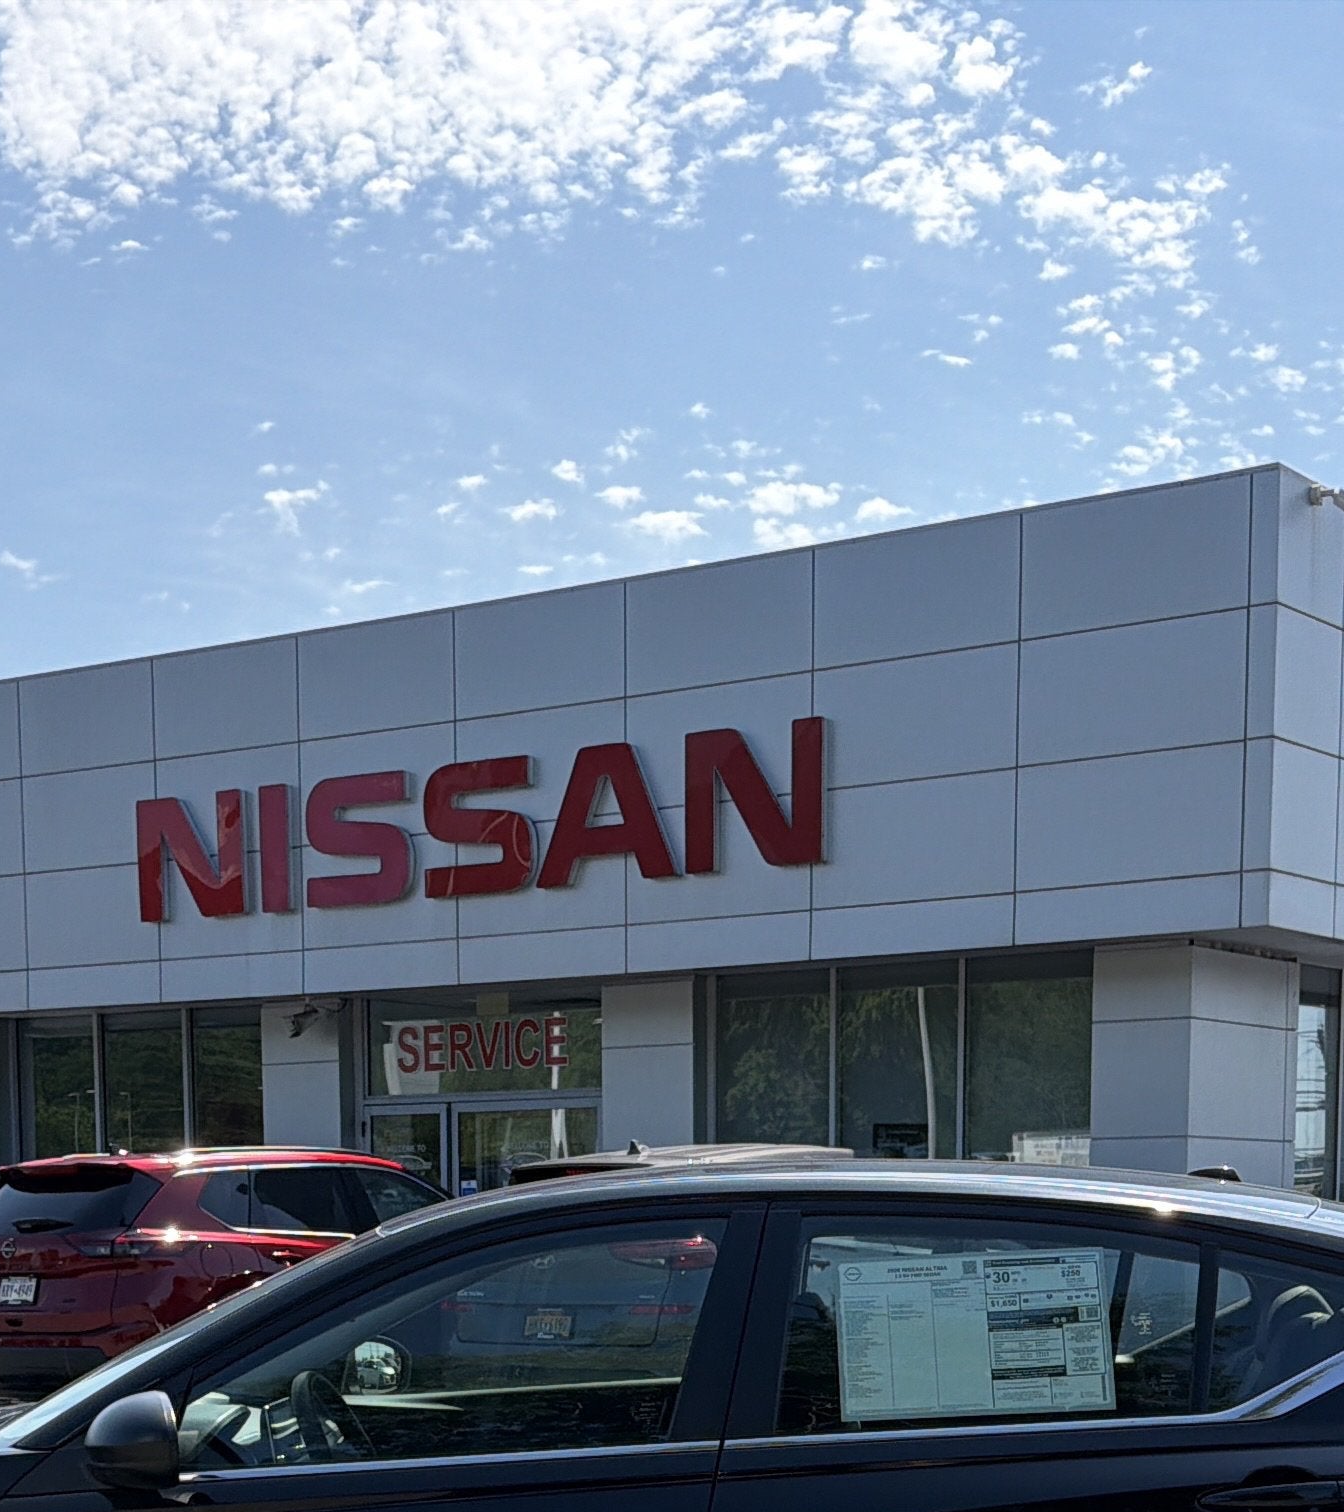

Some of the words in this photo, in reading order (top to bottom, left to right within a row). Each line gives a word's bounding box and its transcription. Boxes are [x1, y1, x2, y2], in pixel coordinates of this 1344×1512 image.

[136, 716, 827, 922] NISSAN
[397, 1017, 569, 1073] SERVICE
[992, 1271, 1010, 1283] 30
